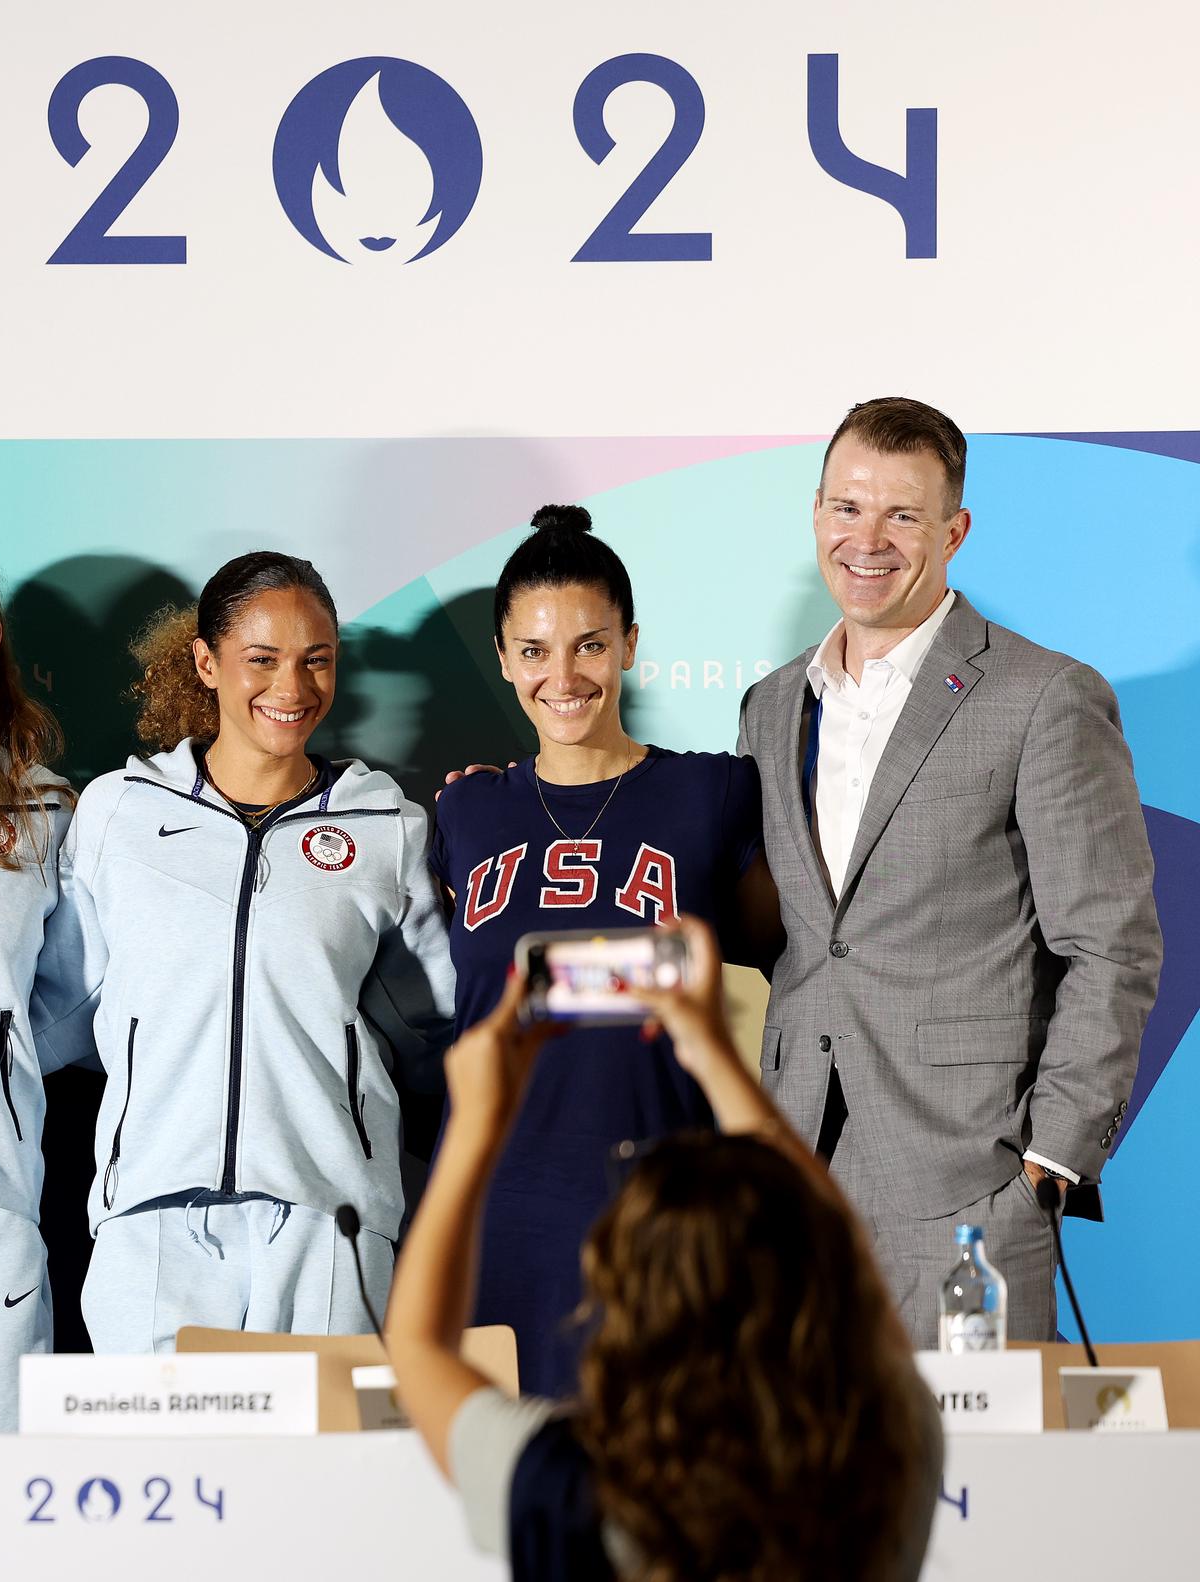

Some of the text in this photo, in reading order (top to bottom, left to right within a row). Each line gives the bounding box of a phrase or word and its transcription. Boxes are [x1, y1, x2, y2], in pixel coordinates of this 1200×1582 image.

[46, 52, 938, 266] 2024
[464, 839, 681, 932] USA
[64, 1392, 273, 1413] Daniella RAMIREZ
[25, 1475, 225, 1523] 2024
